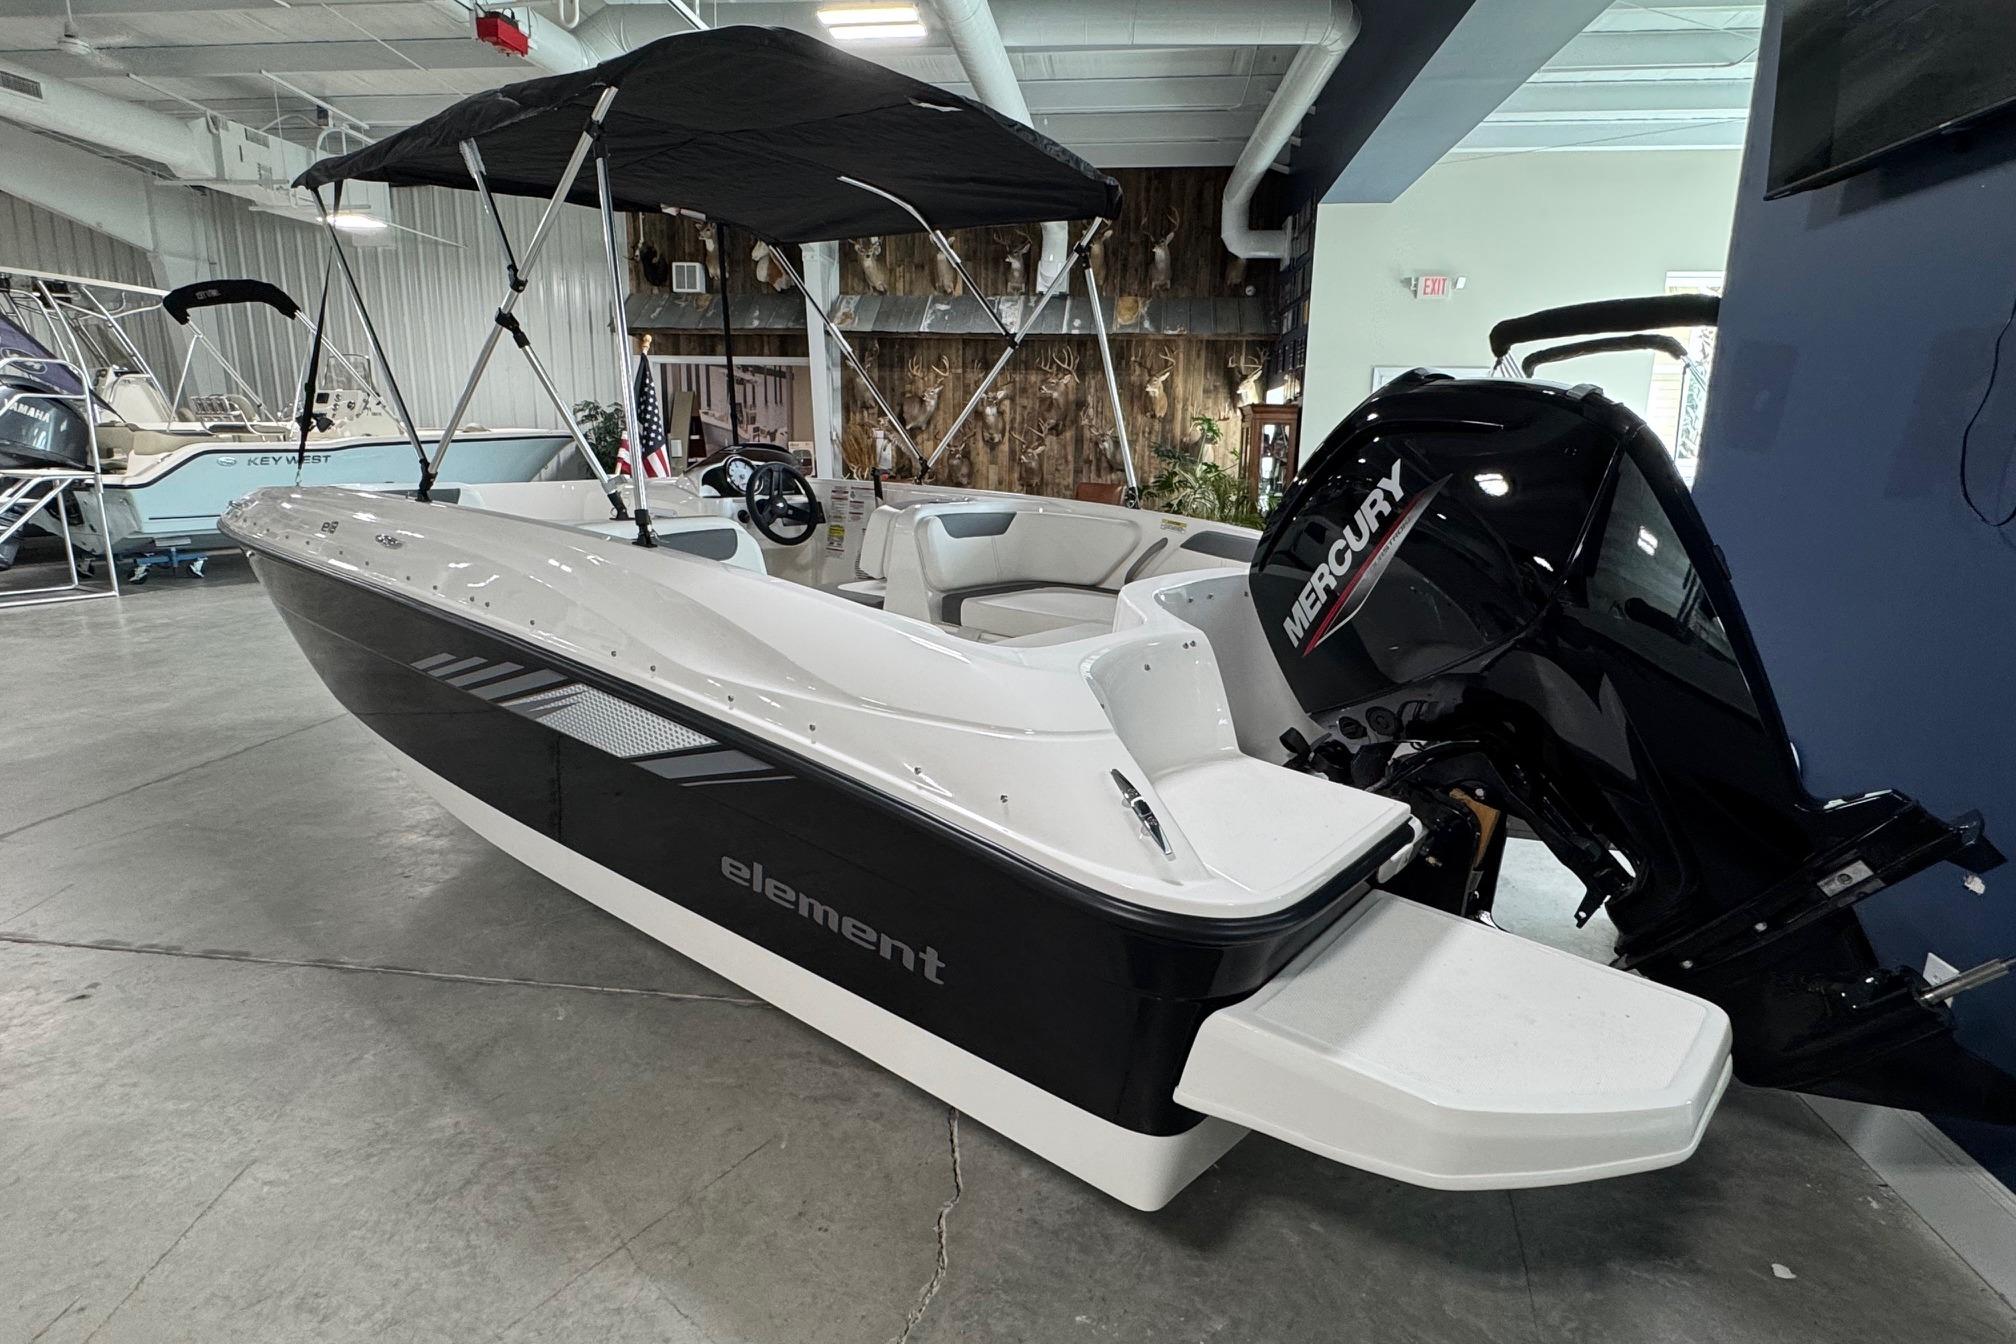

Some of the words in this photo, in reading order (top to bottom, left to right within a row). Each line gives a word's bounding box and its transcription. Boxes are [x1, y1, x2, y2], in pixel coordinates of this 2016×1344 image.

[1423, 277, 1448, 296] EXIT
[247, 456, 283, 466] KEY
[1283, 458, 1404, 648] MERCURY
[721, 856, 946, 985] element
